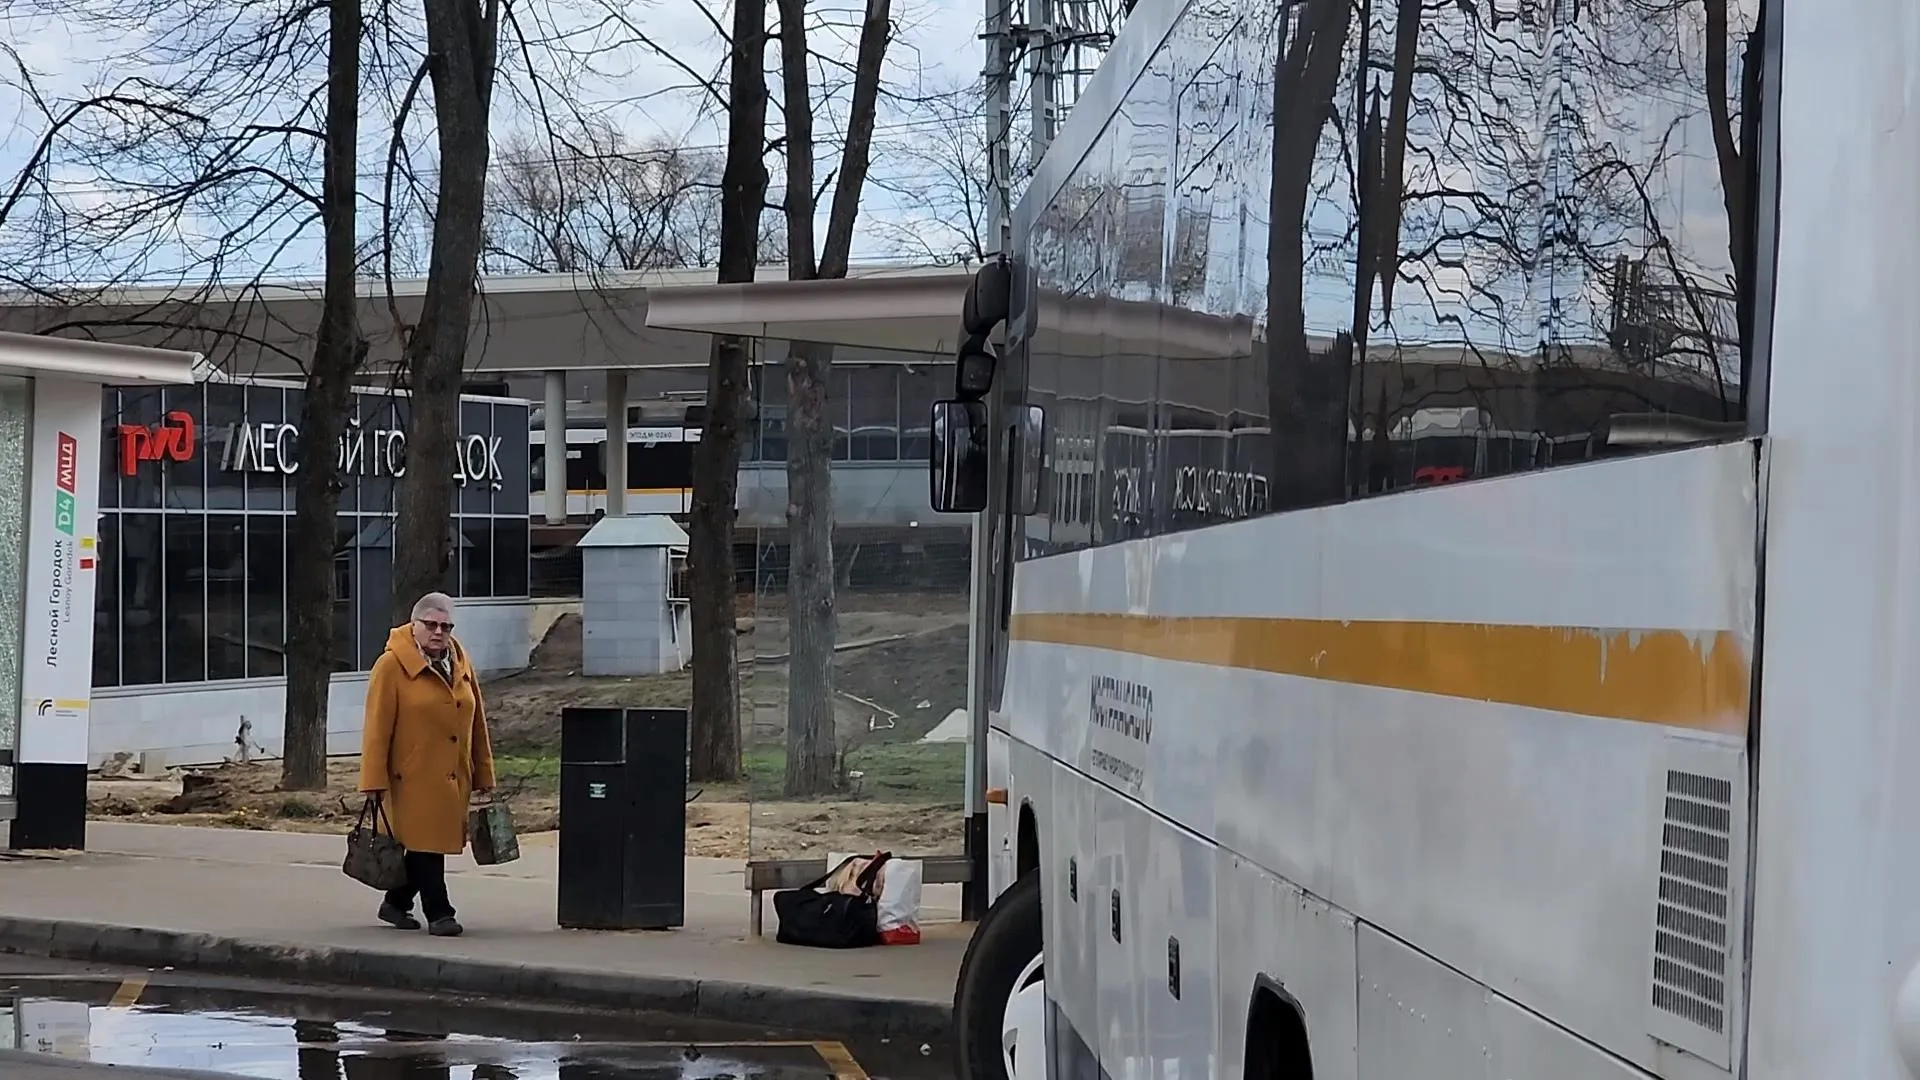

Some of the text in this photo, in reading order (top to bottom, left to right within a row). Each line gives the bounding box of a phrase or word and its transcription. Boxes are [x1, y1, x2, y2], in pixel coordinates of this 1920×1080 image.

[60, 442, 73, 486] МЦД
[233, 417, 503, 487] ЛЕСЙ ГОДОК
[58, 499, 72, 526] D4
[46, 539, 63, 667] Лесной Городок
[63, 541, 74, 623] Lesnoy Gorodok
